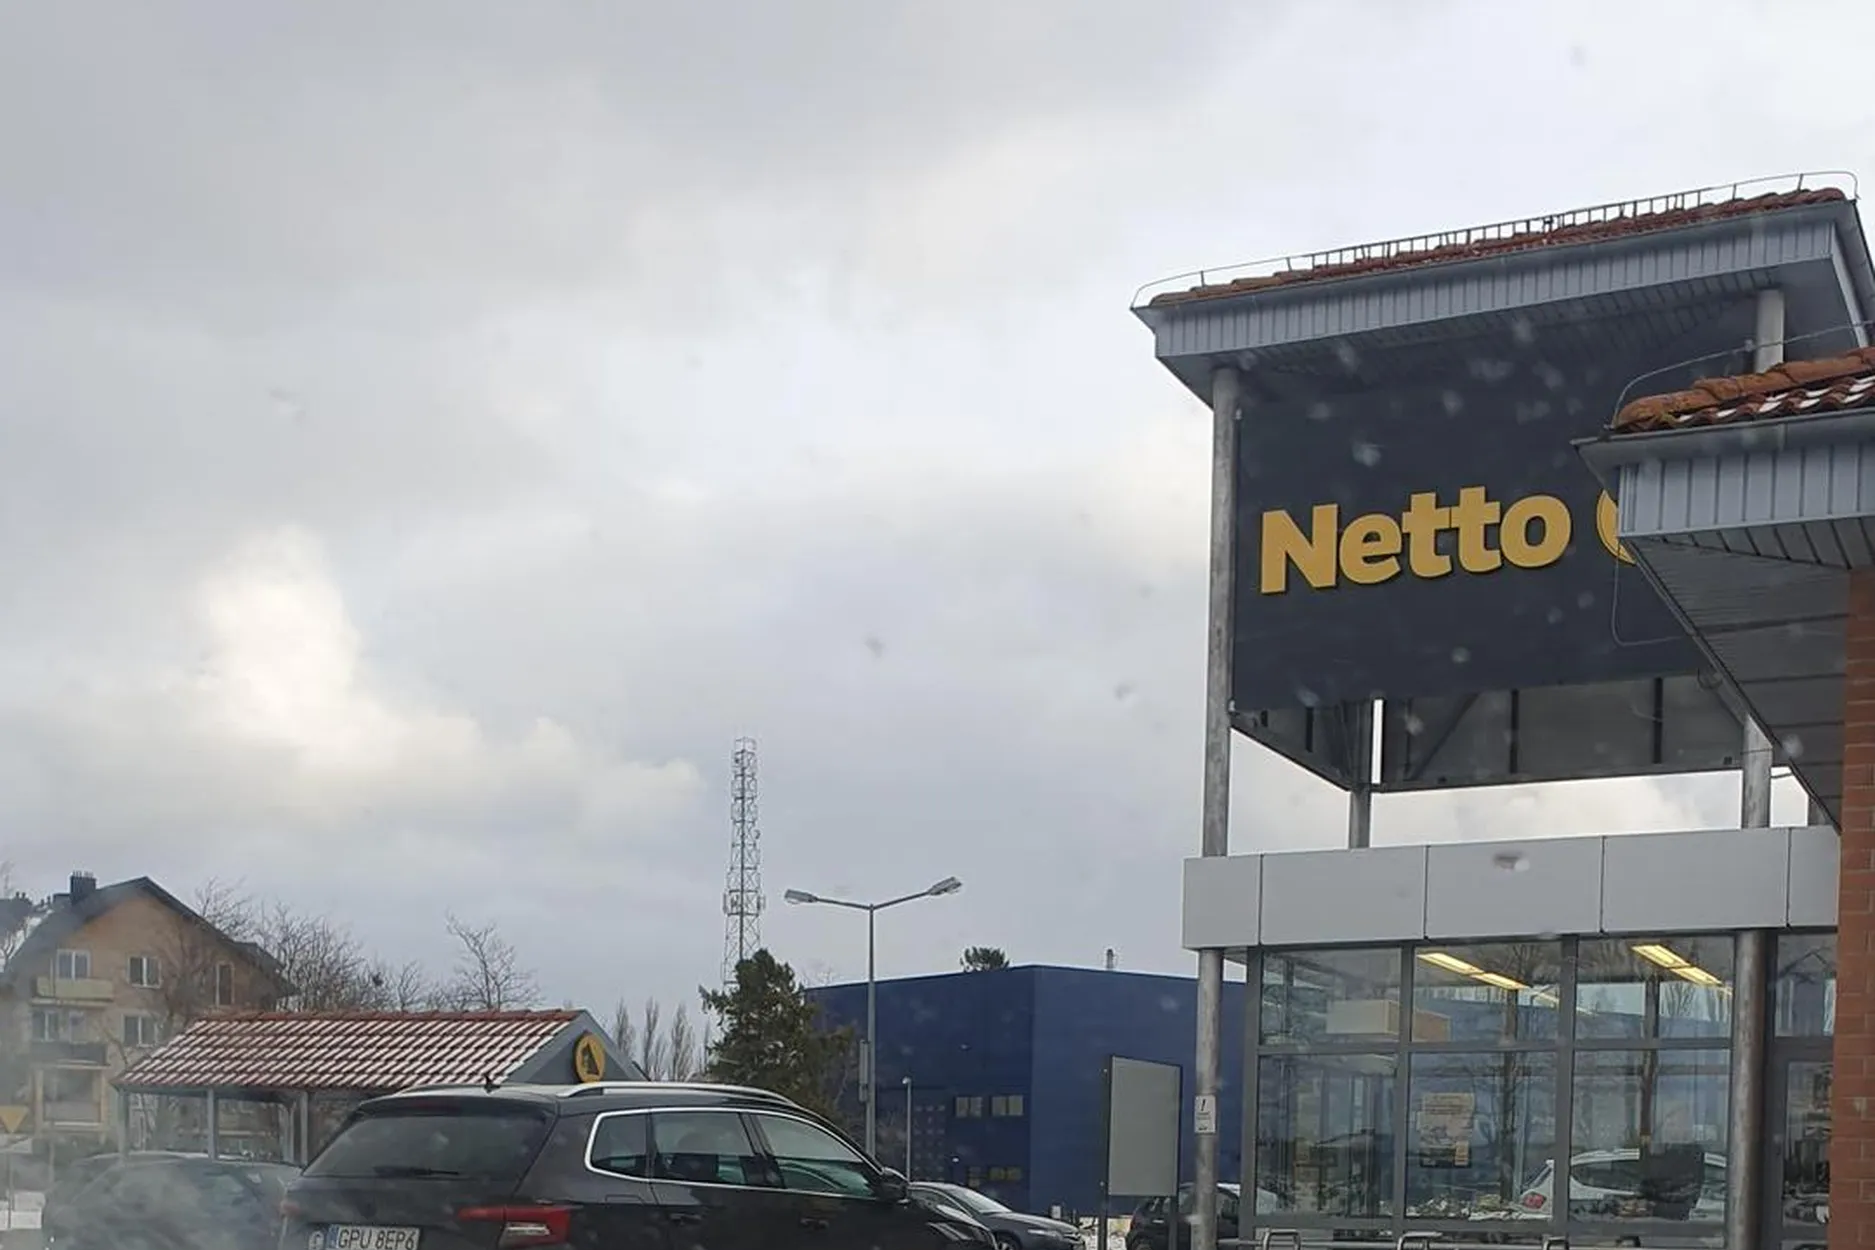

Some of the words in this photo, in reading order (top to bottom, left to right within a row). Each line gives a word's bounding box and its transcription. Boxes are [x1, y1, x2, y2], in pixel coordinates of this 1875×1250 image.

[1260, 485, 1572, 595] Netto
[338, 1229, 373, 1249] GPU
[375, 1229, 416, 1250] 8EP6
